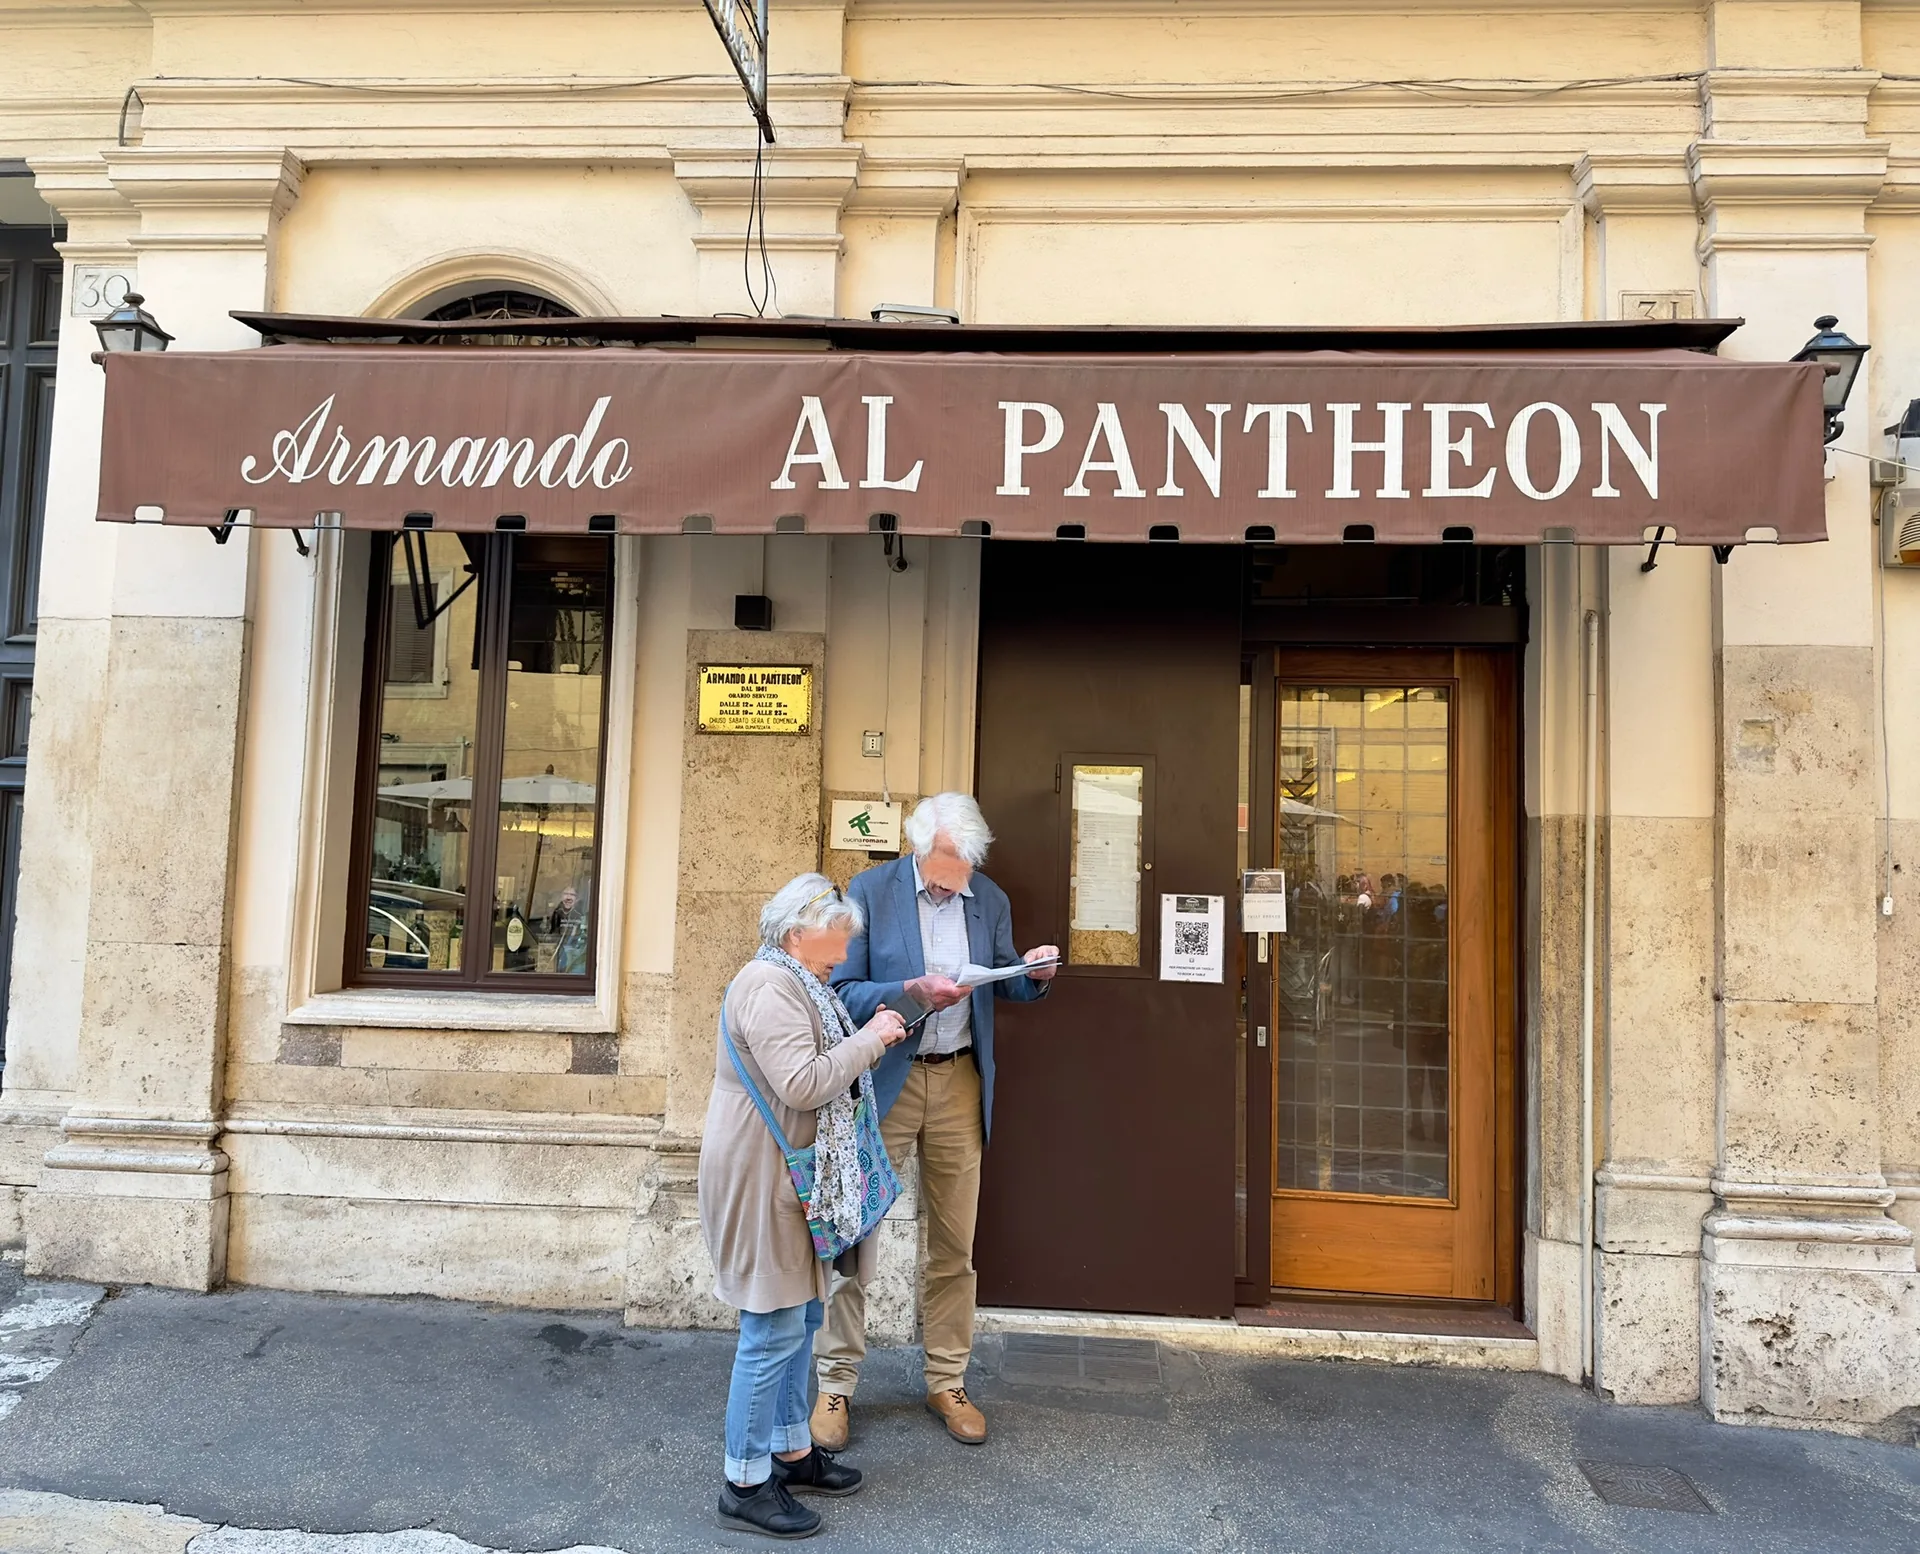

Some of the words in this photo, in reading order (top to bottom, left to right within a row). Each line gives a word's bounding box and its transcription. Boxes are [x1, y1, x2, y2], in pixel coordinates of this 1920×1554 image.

[81, 274, 131, 308] 30
[1637, 300, 1680, 320] 31
[241, 393, 633, 489] Armando
[770, 395, 924, 493] AL
[995, 400, 1667, 501] PANTHEON
[706, 673, 746, 684] ARMANDO
[748, 674, 758, 684] AL
[760, 674, 802, 685] PANTHEON
